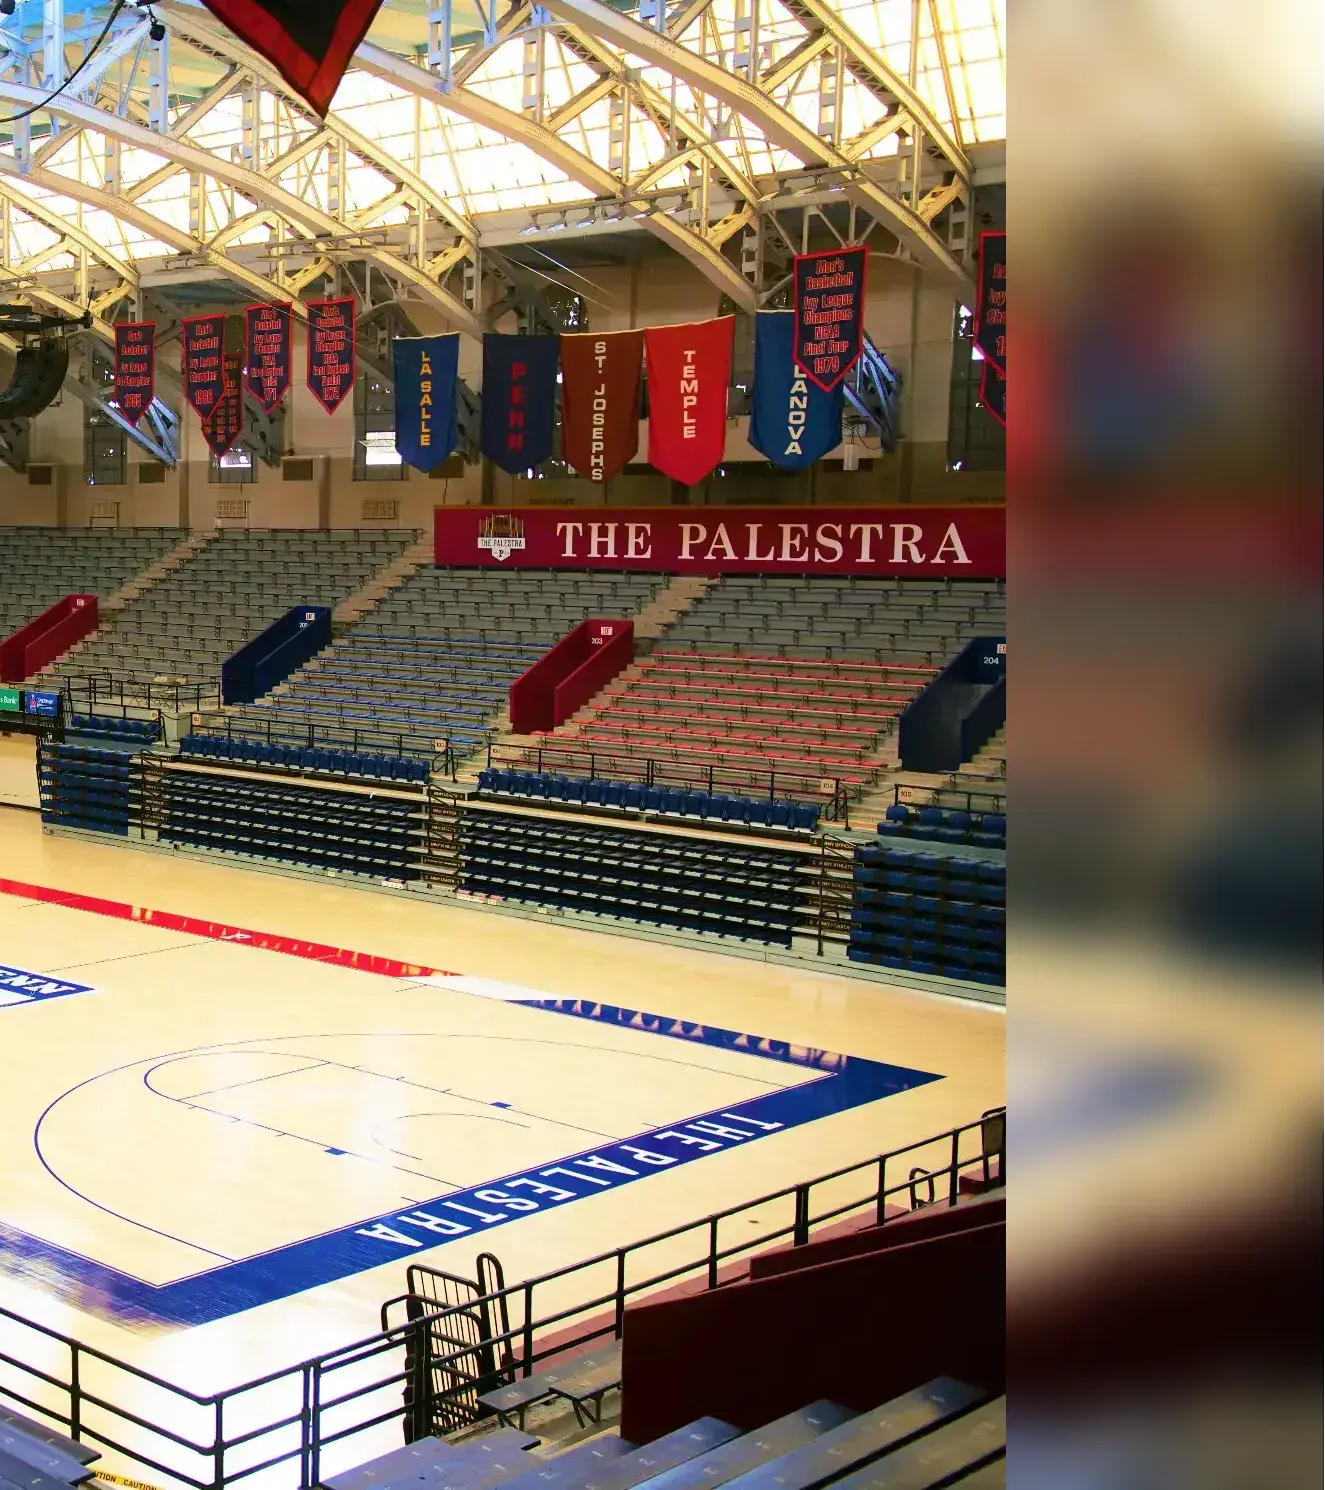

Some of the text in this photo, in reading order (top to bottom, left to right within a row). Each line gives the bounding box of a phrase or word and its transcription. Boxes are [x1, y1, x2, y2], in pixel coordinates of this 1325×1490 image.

[816, 258, 844, 274] Men's
[806, 272, 853, 290] Basketball
[804, 293, 853, 311] Ivy League
[804, 309, 852, 324] Champions
[815, 325, 839, 340] NCAA
[804, 340, 849, 355] Final Four
[594, 341, 607, 374] ST.
[814, 356, 840, 374] 1979
[420, 351, 433, 446] LA SALLE
[680, 350, 699, 439] TEMPLE
[506, 362, 526, 452] PENN
[481, 539, 523, 548] THE PALESTRA
[556, 522, 973, 564] THE PALESTRA
[498, 549, 504, 557] P
[591, 637, 603, 645] 203
[983, 656, 999, 665] 204
[4, 695, 17, 705] Bank
[353, 1112, 784, 1248] THE PALESTRA
